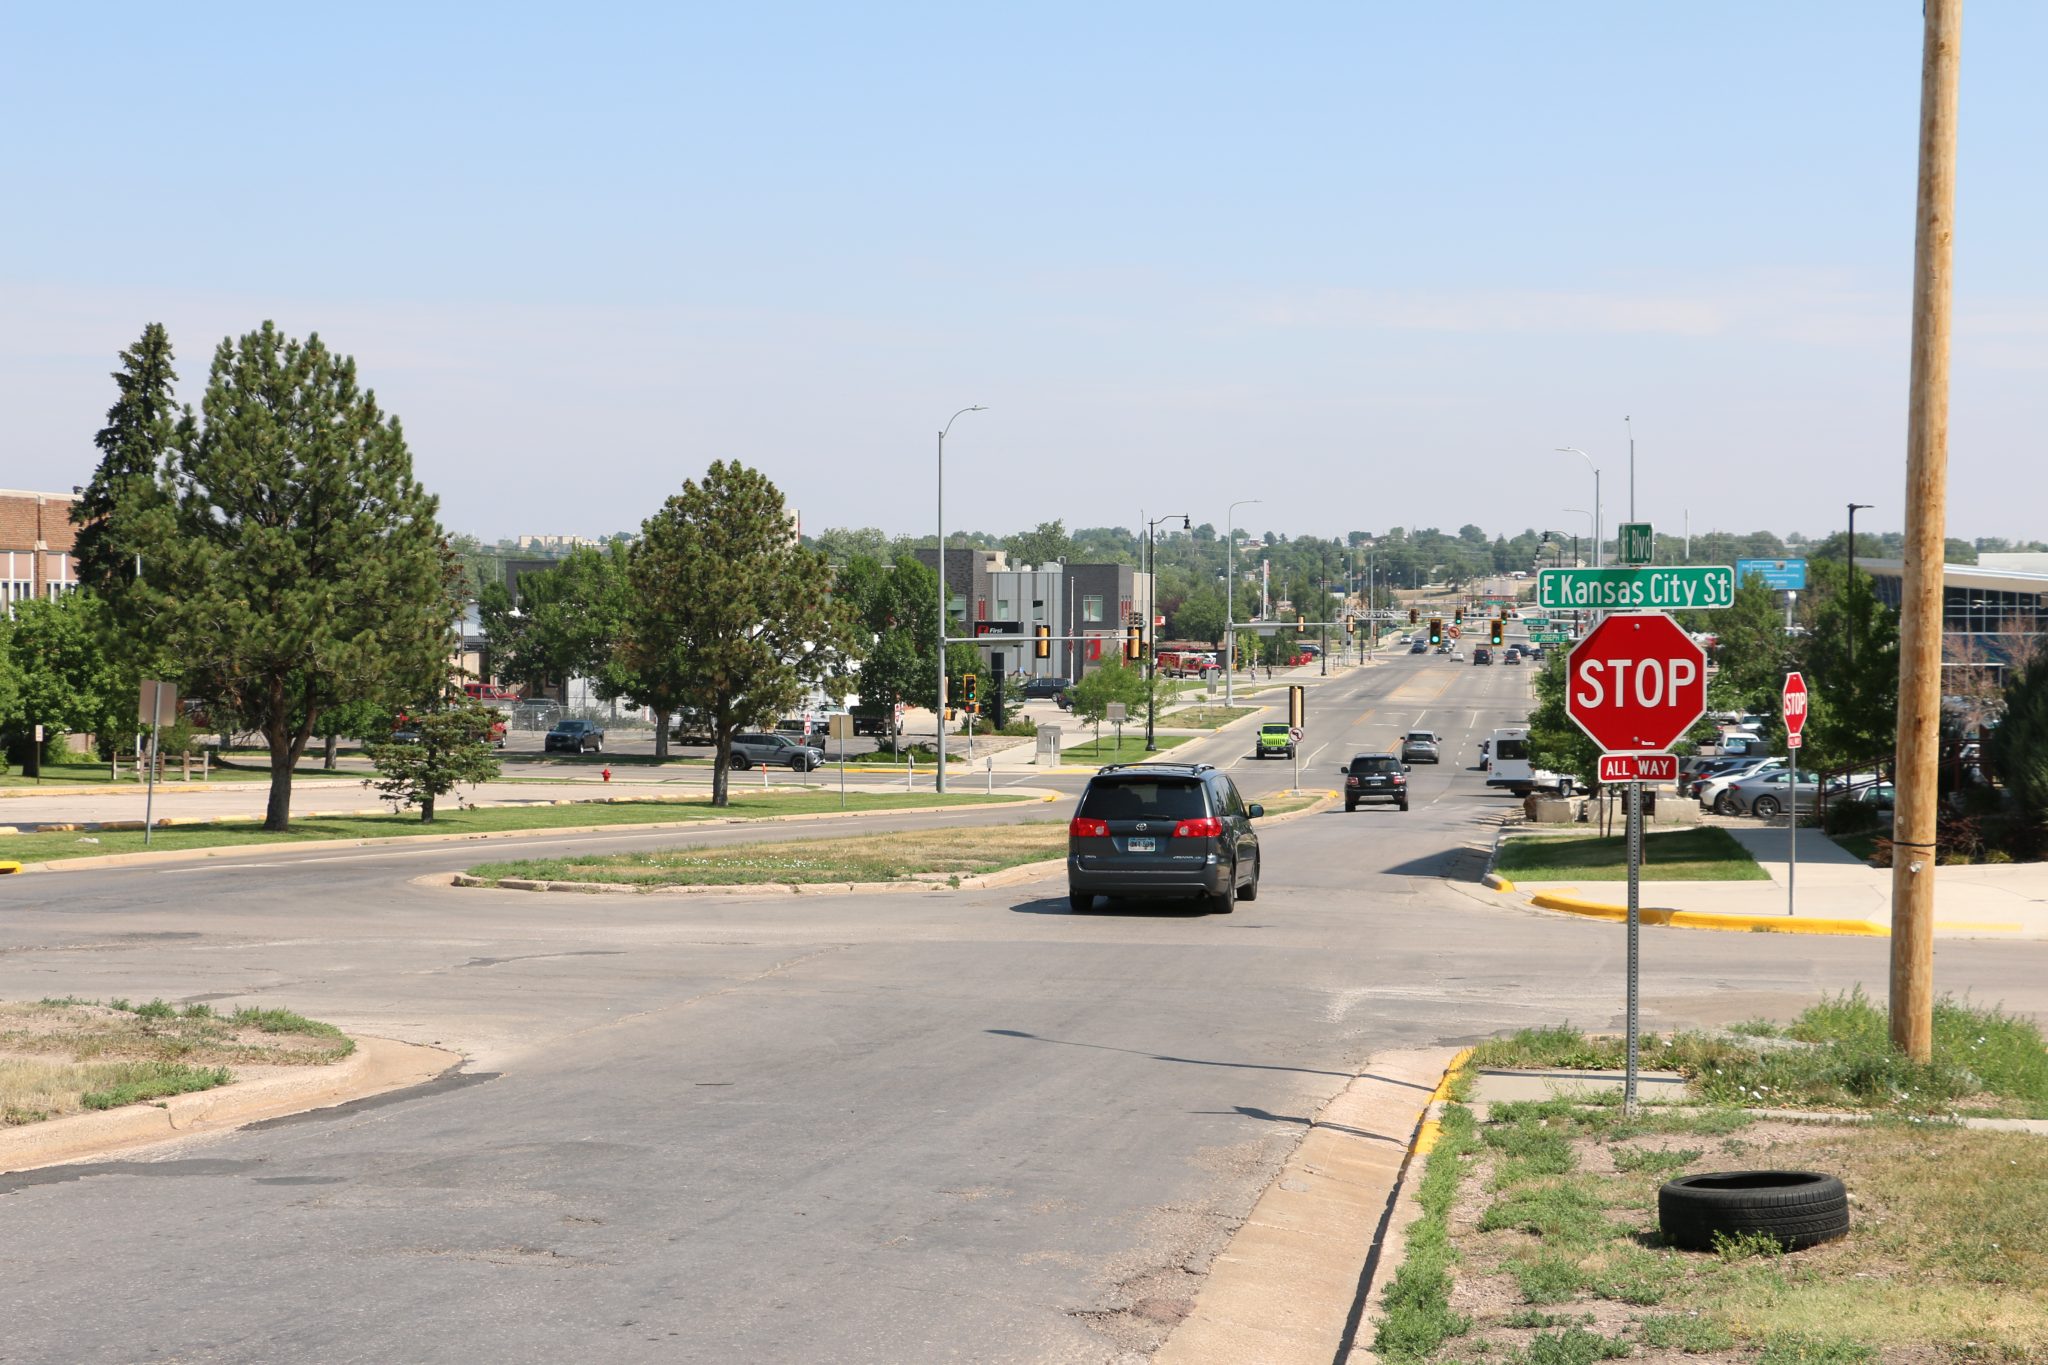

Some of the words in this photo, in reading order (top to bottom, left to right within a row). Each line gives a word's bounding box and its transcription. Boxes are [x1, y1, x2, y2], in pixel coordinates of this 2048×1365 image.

[1632, 529, 1650, 559] Blvd
[1543, 575, 1555, 604] E
[1561, 574, 1645, 605] Kansas
[1650, 573, 1697, 607] City
[1703, 572, 1728, 603] St
[1540, 633, 1560, 642] JOSEPH
[1577, 657, 1697, 709] STOP
[1785, 691, 1806, 716] STOP
[1606, 760, 1631, 776] ALL
[1638, 760, 1670, 776] WAY
